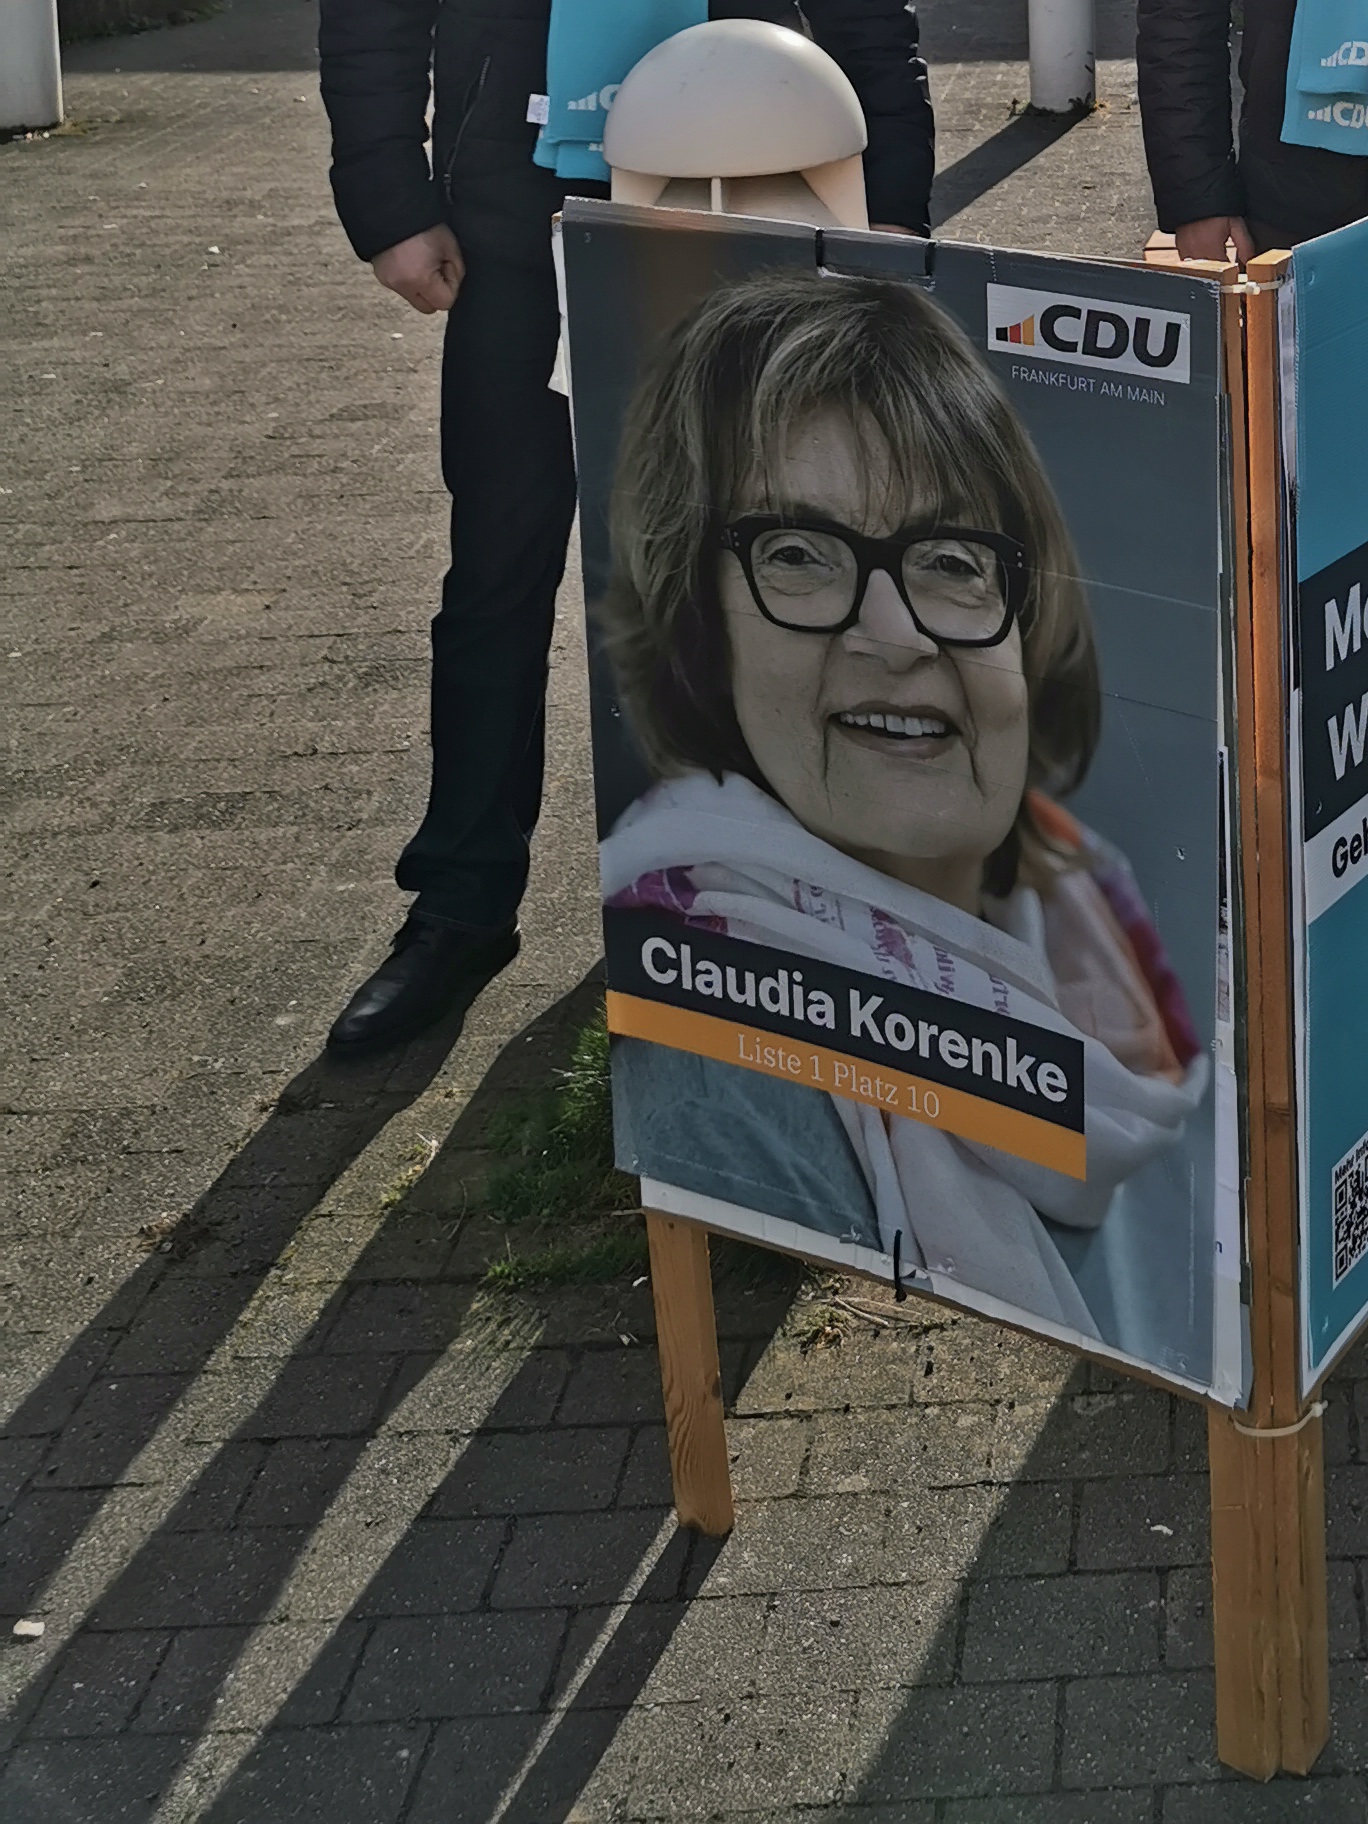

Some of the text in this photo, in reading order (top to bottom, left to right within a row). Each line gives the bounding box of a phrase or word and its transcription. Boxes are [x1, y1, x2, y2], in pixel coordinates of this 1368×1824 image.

[1039, 304, 1182, 368] CDU
[1011, 365, 1165, 407] FRANKFURT AM MAIN
[641, 936, 836, 1030] Claudia
[849, 990, 1069, 1104] Korenke
[737, 1032, 941, 1119] Liste 1 Platz 10
[1335, 1154, 1355, 1185] Mehr
